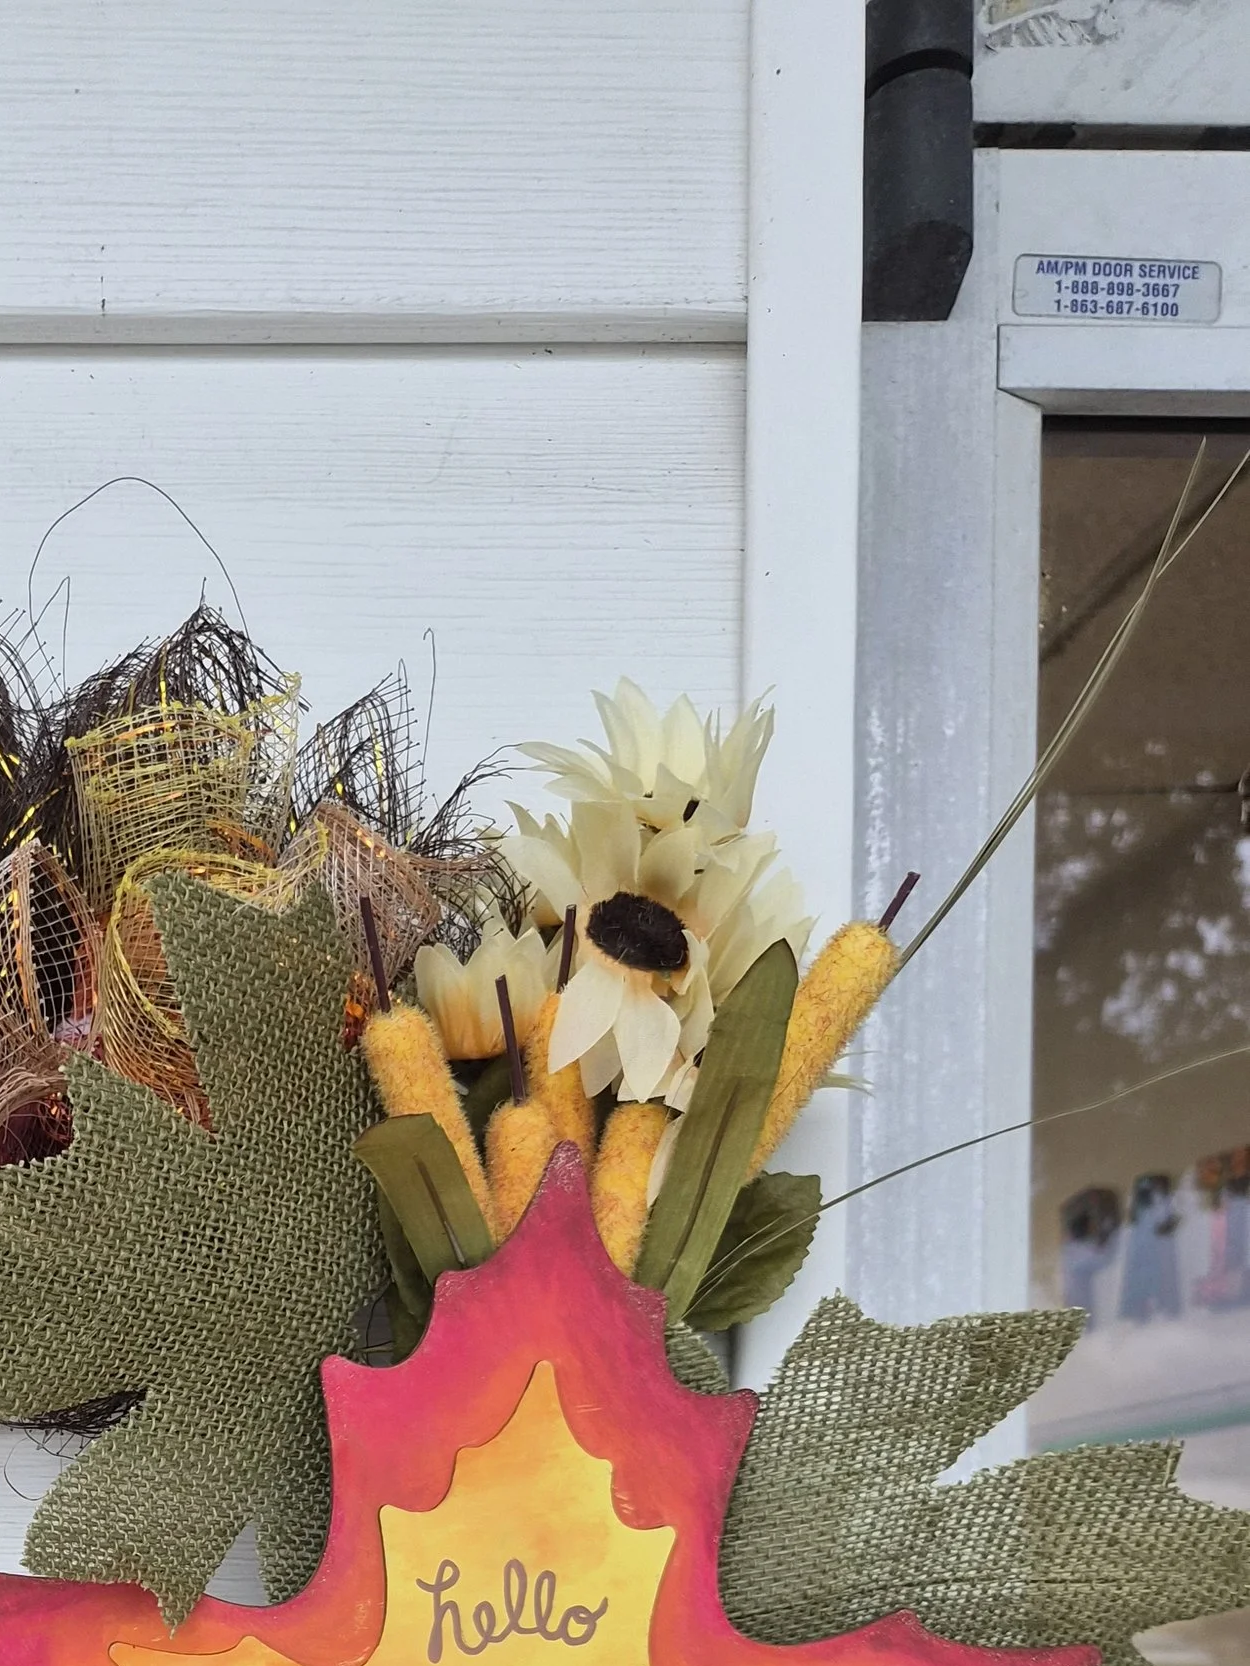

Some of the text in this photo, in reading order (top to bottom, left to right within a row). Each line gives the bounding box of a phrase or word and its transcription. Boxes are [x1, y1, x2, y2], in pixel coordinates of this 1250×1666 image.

[1036, 260, 1200, 280] AM/PM DOOR SERVICE
[1055, 280, 1180, 298] 1-888-898-3667
[1054, 299, 1179, 317] 1-863-687-6100
[416, 1558, 609, 1664] hello
